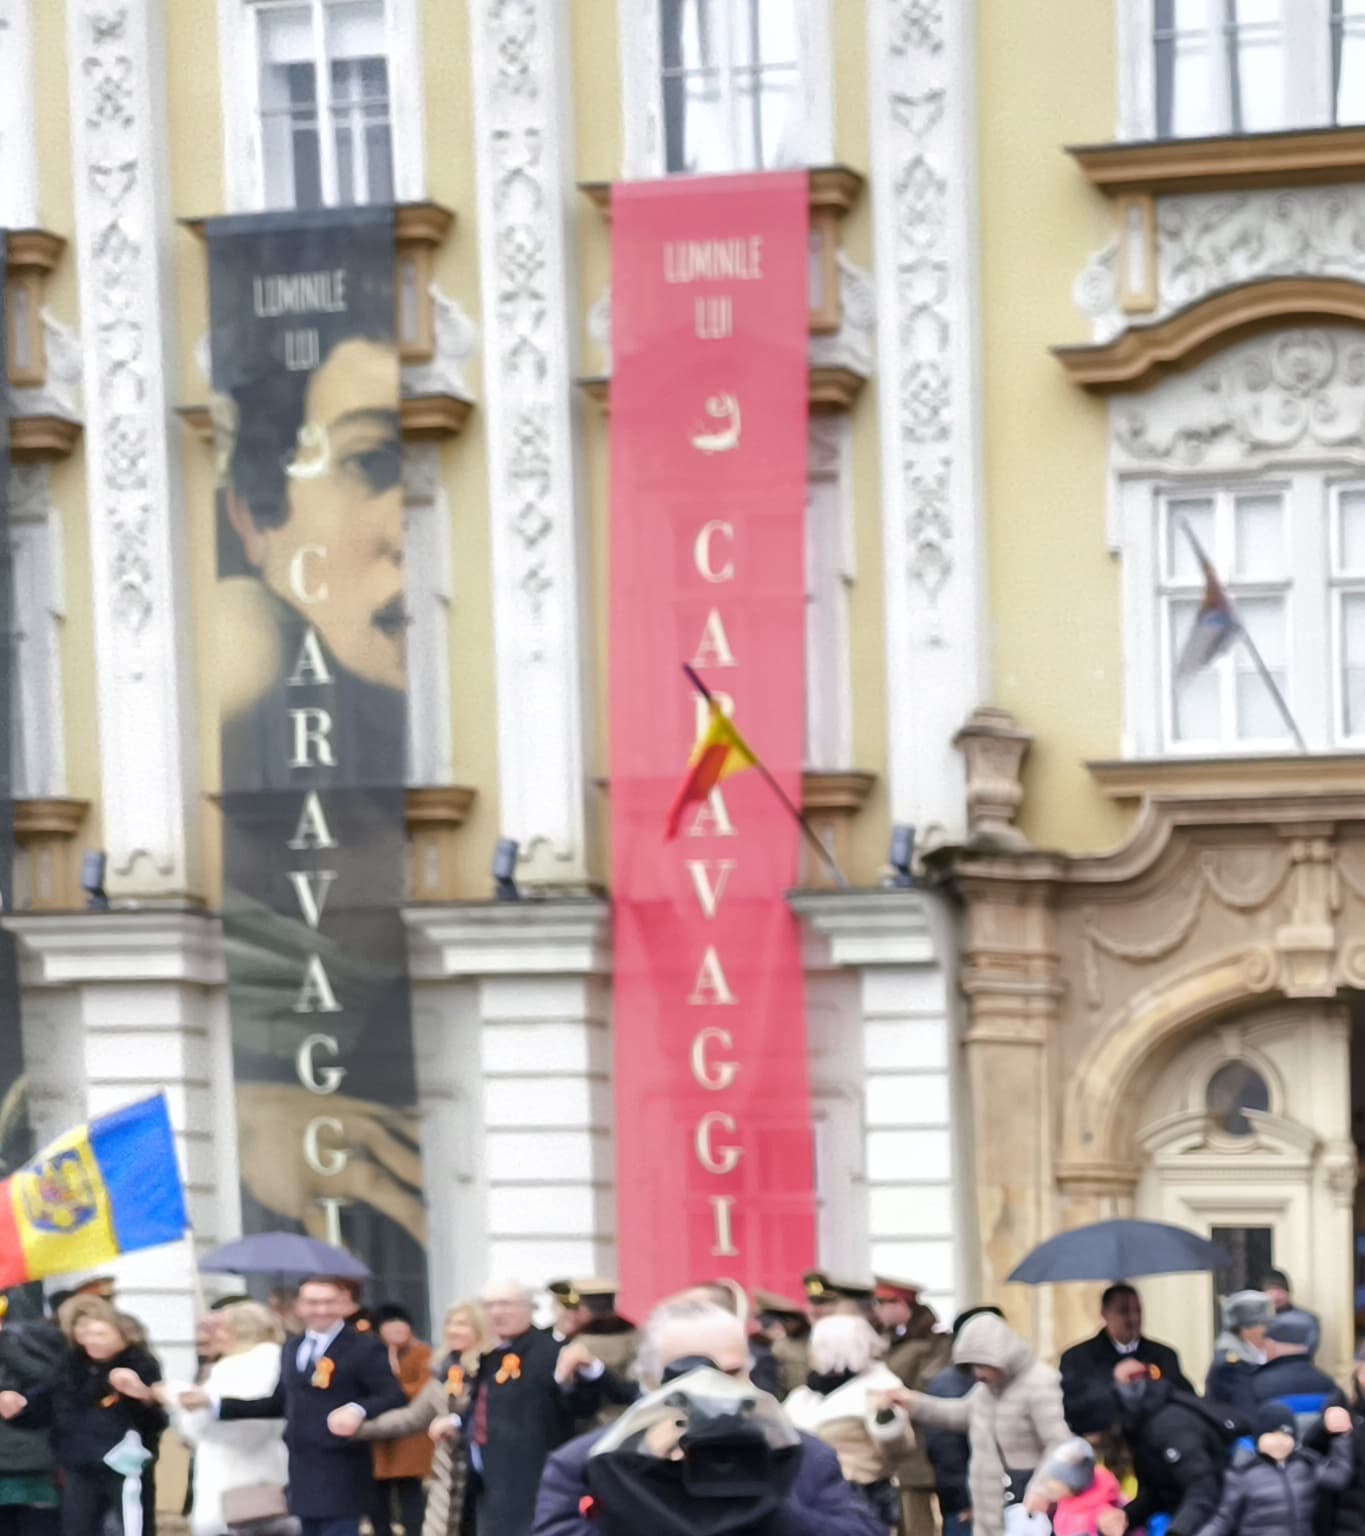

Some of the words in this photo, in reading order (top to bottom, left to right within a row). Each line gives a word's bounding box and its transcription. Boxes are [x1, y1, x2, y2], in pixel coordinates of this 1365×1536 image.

[663, 234, 764, 283] LUMINILE
[252, 268, 348, 318] LUMINILE
[694, 296, 734, 340] LUI
[284, 327, 320, 372] LUI
[685, 520, 749, 1326] CARAVAGGI
